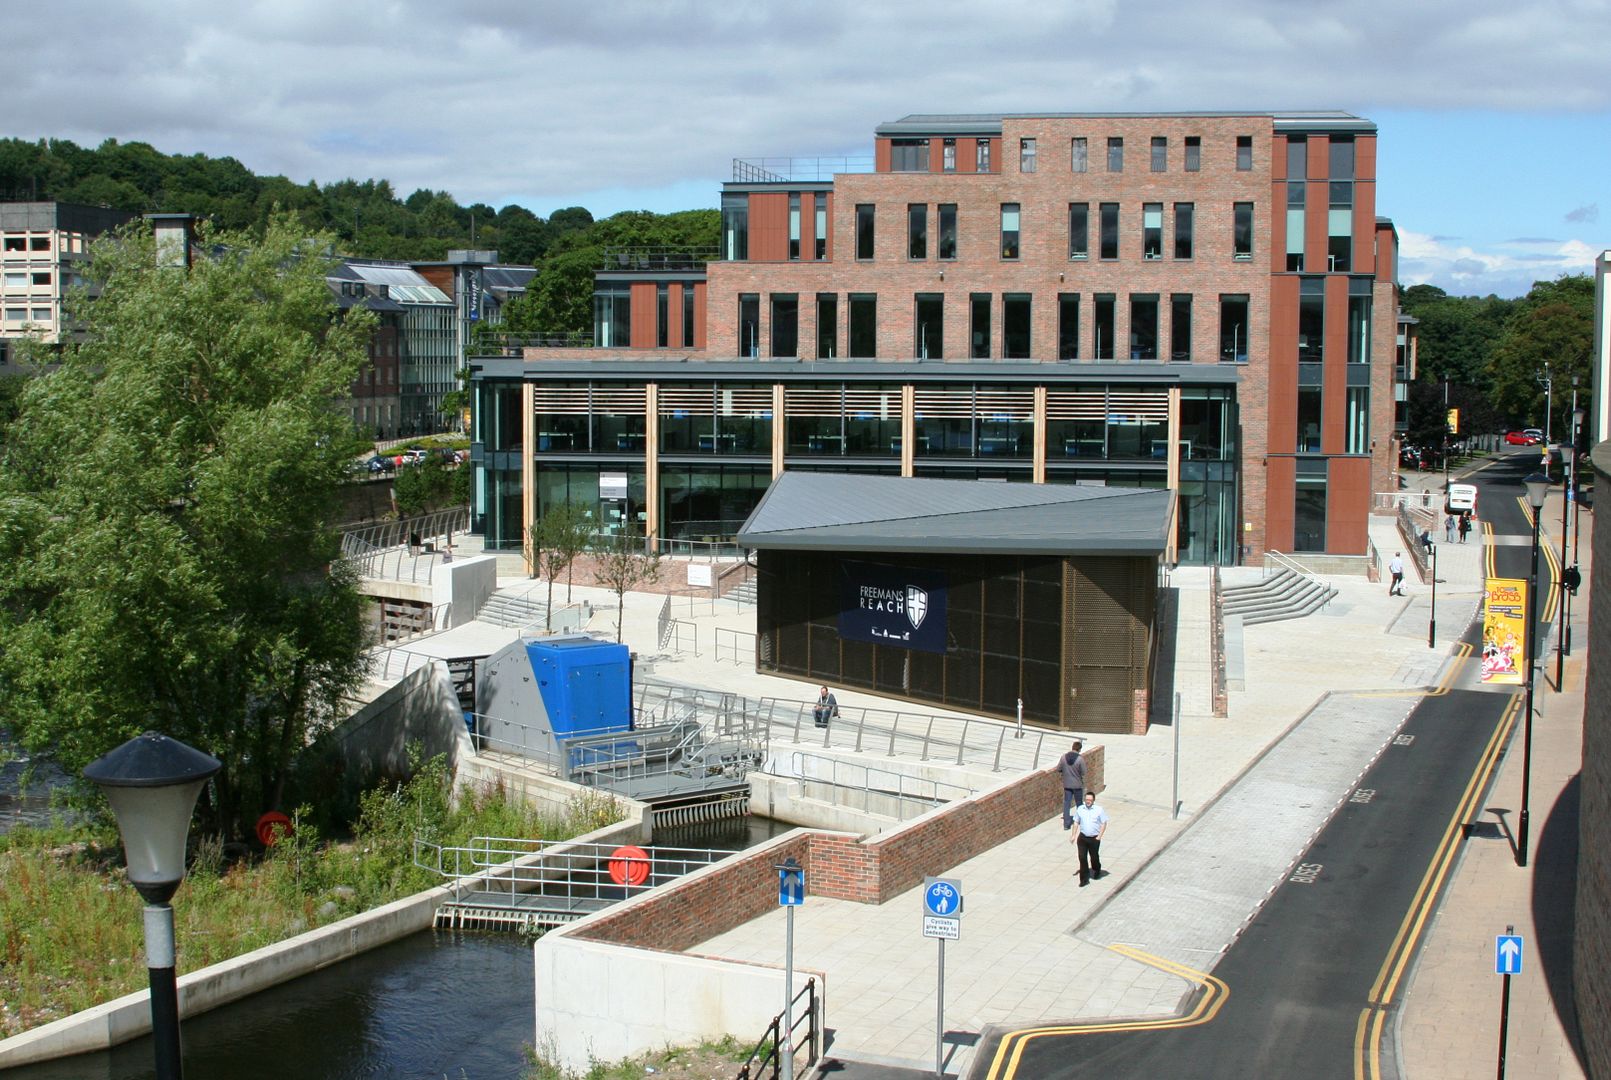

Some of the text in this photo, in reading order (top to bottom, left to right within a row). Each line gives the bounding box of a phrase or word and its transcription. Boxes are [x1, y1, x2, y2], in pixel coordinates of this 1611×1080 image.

[860, 585, 904, 602] FREEMANS
[860, 597, 904, 614] REACH
[1349, 788, 1376, 804] BUSES
[1289, 862, 1323, 884] BUSES
